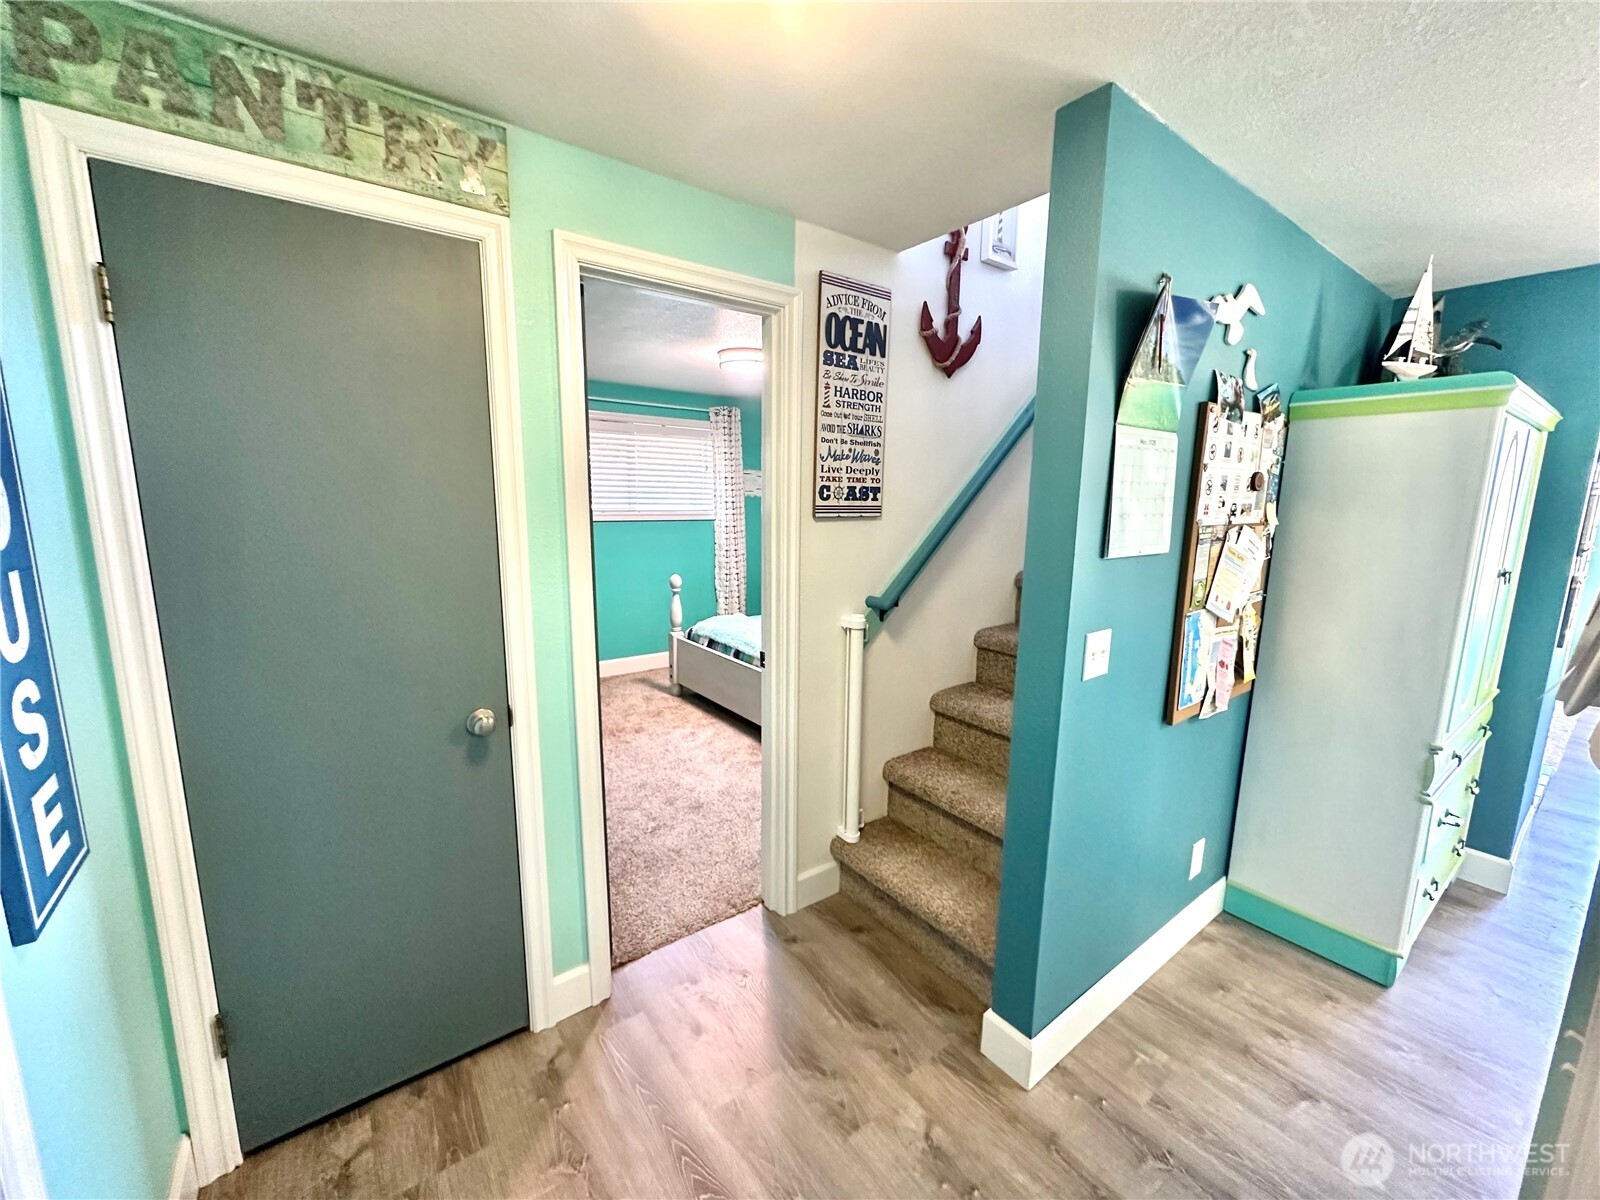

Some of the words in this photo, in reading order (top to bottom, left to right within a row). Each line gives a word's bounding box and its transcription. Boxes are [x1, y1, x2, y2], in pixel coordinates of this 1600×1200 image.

[10, 0, 497, 196] PANTRY
[826, 294, 860, 308] ADVICE
[861, 297, 887, 322] FROM
[850, 307, 864, 317] THE
[824, 311, 888, 358] OCEAN
[822, 349, 859, 371] SEA
[860, 363, 886, 374] BEAUTY
[851, 374, 885, 388] Smile
[833, 385, 883, 403] HARBOR
[835, 399, 881, 413] STRENGTH
[863, 413, 883, 423] SHELL
[821, 423, 836, 434] AVOID
[836, 424, 847, 435] THE
[847, 421, 883, 438] SHARKS
[820, 436, 838, 445] Don't
[840, 438, 849, 446] Be
[849, 439, 882, 448] Shellfish
[819, 445, 852, 463] Make
[850, 447, 882, 467] Waves
[820, 464, 843, 474] Live
[845, 465, 880, 477] Deeply
[819, 475, 843, 483] TAKE
[846, 475, 867, 484] TIME
